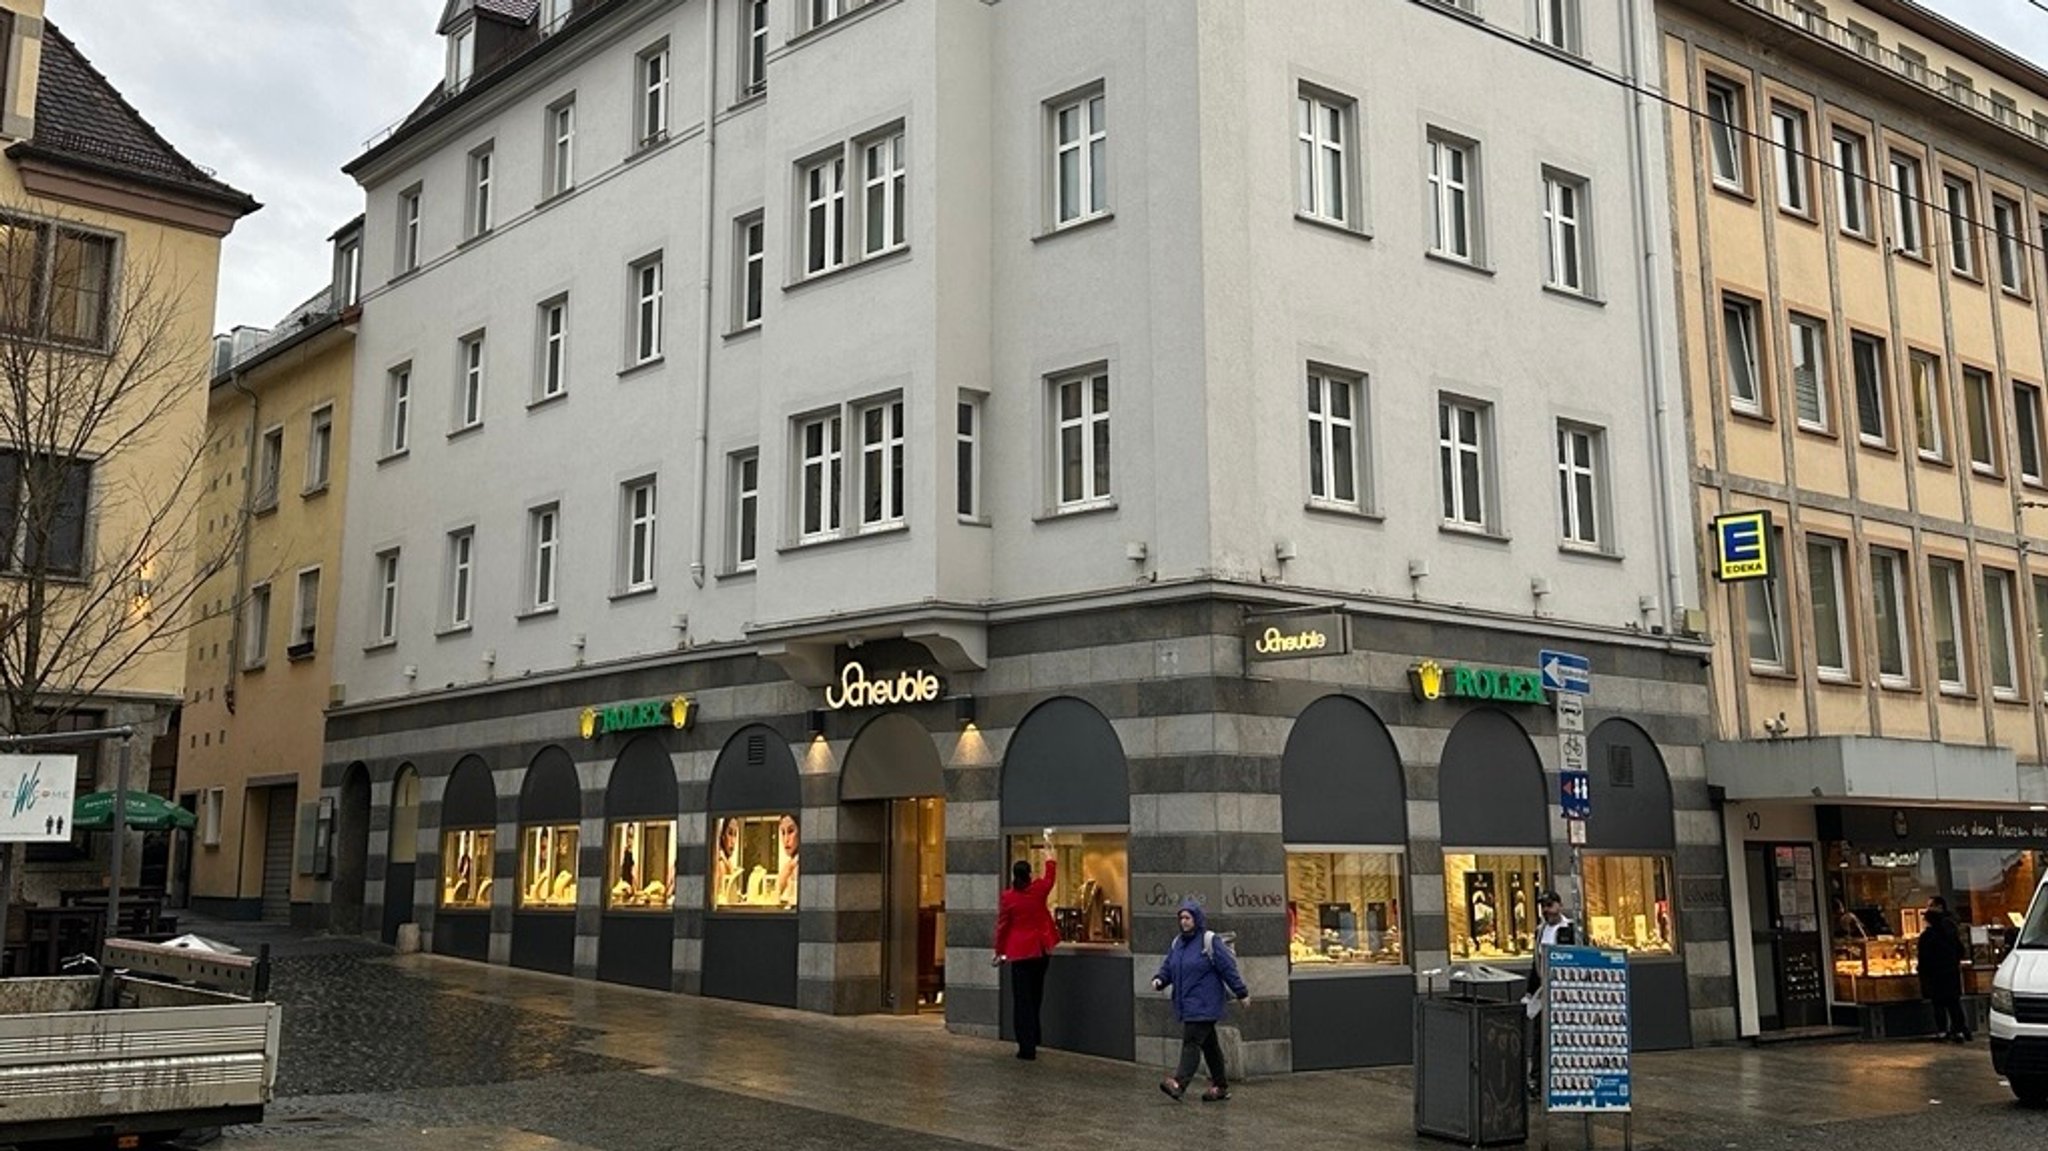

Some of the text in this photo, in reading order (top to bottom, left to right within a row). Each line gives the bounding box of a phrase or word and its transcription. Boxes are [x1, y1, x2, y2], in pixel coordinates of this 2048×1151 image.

[1725, 562, 1763, 574] EDEKA
[1255, 627, 1326, 653] Scheuble
[826, 661, 940, 709] Scheuble
[1454, 665, 1547, 704] ROLEX
[602, 701, 666, 732] ROLEX
[1746, 811, 1761, 831] 10
